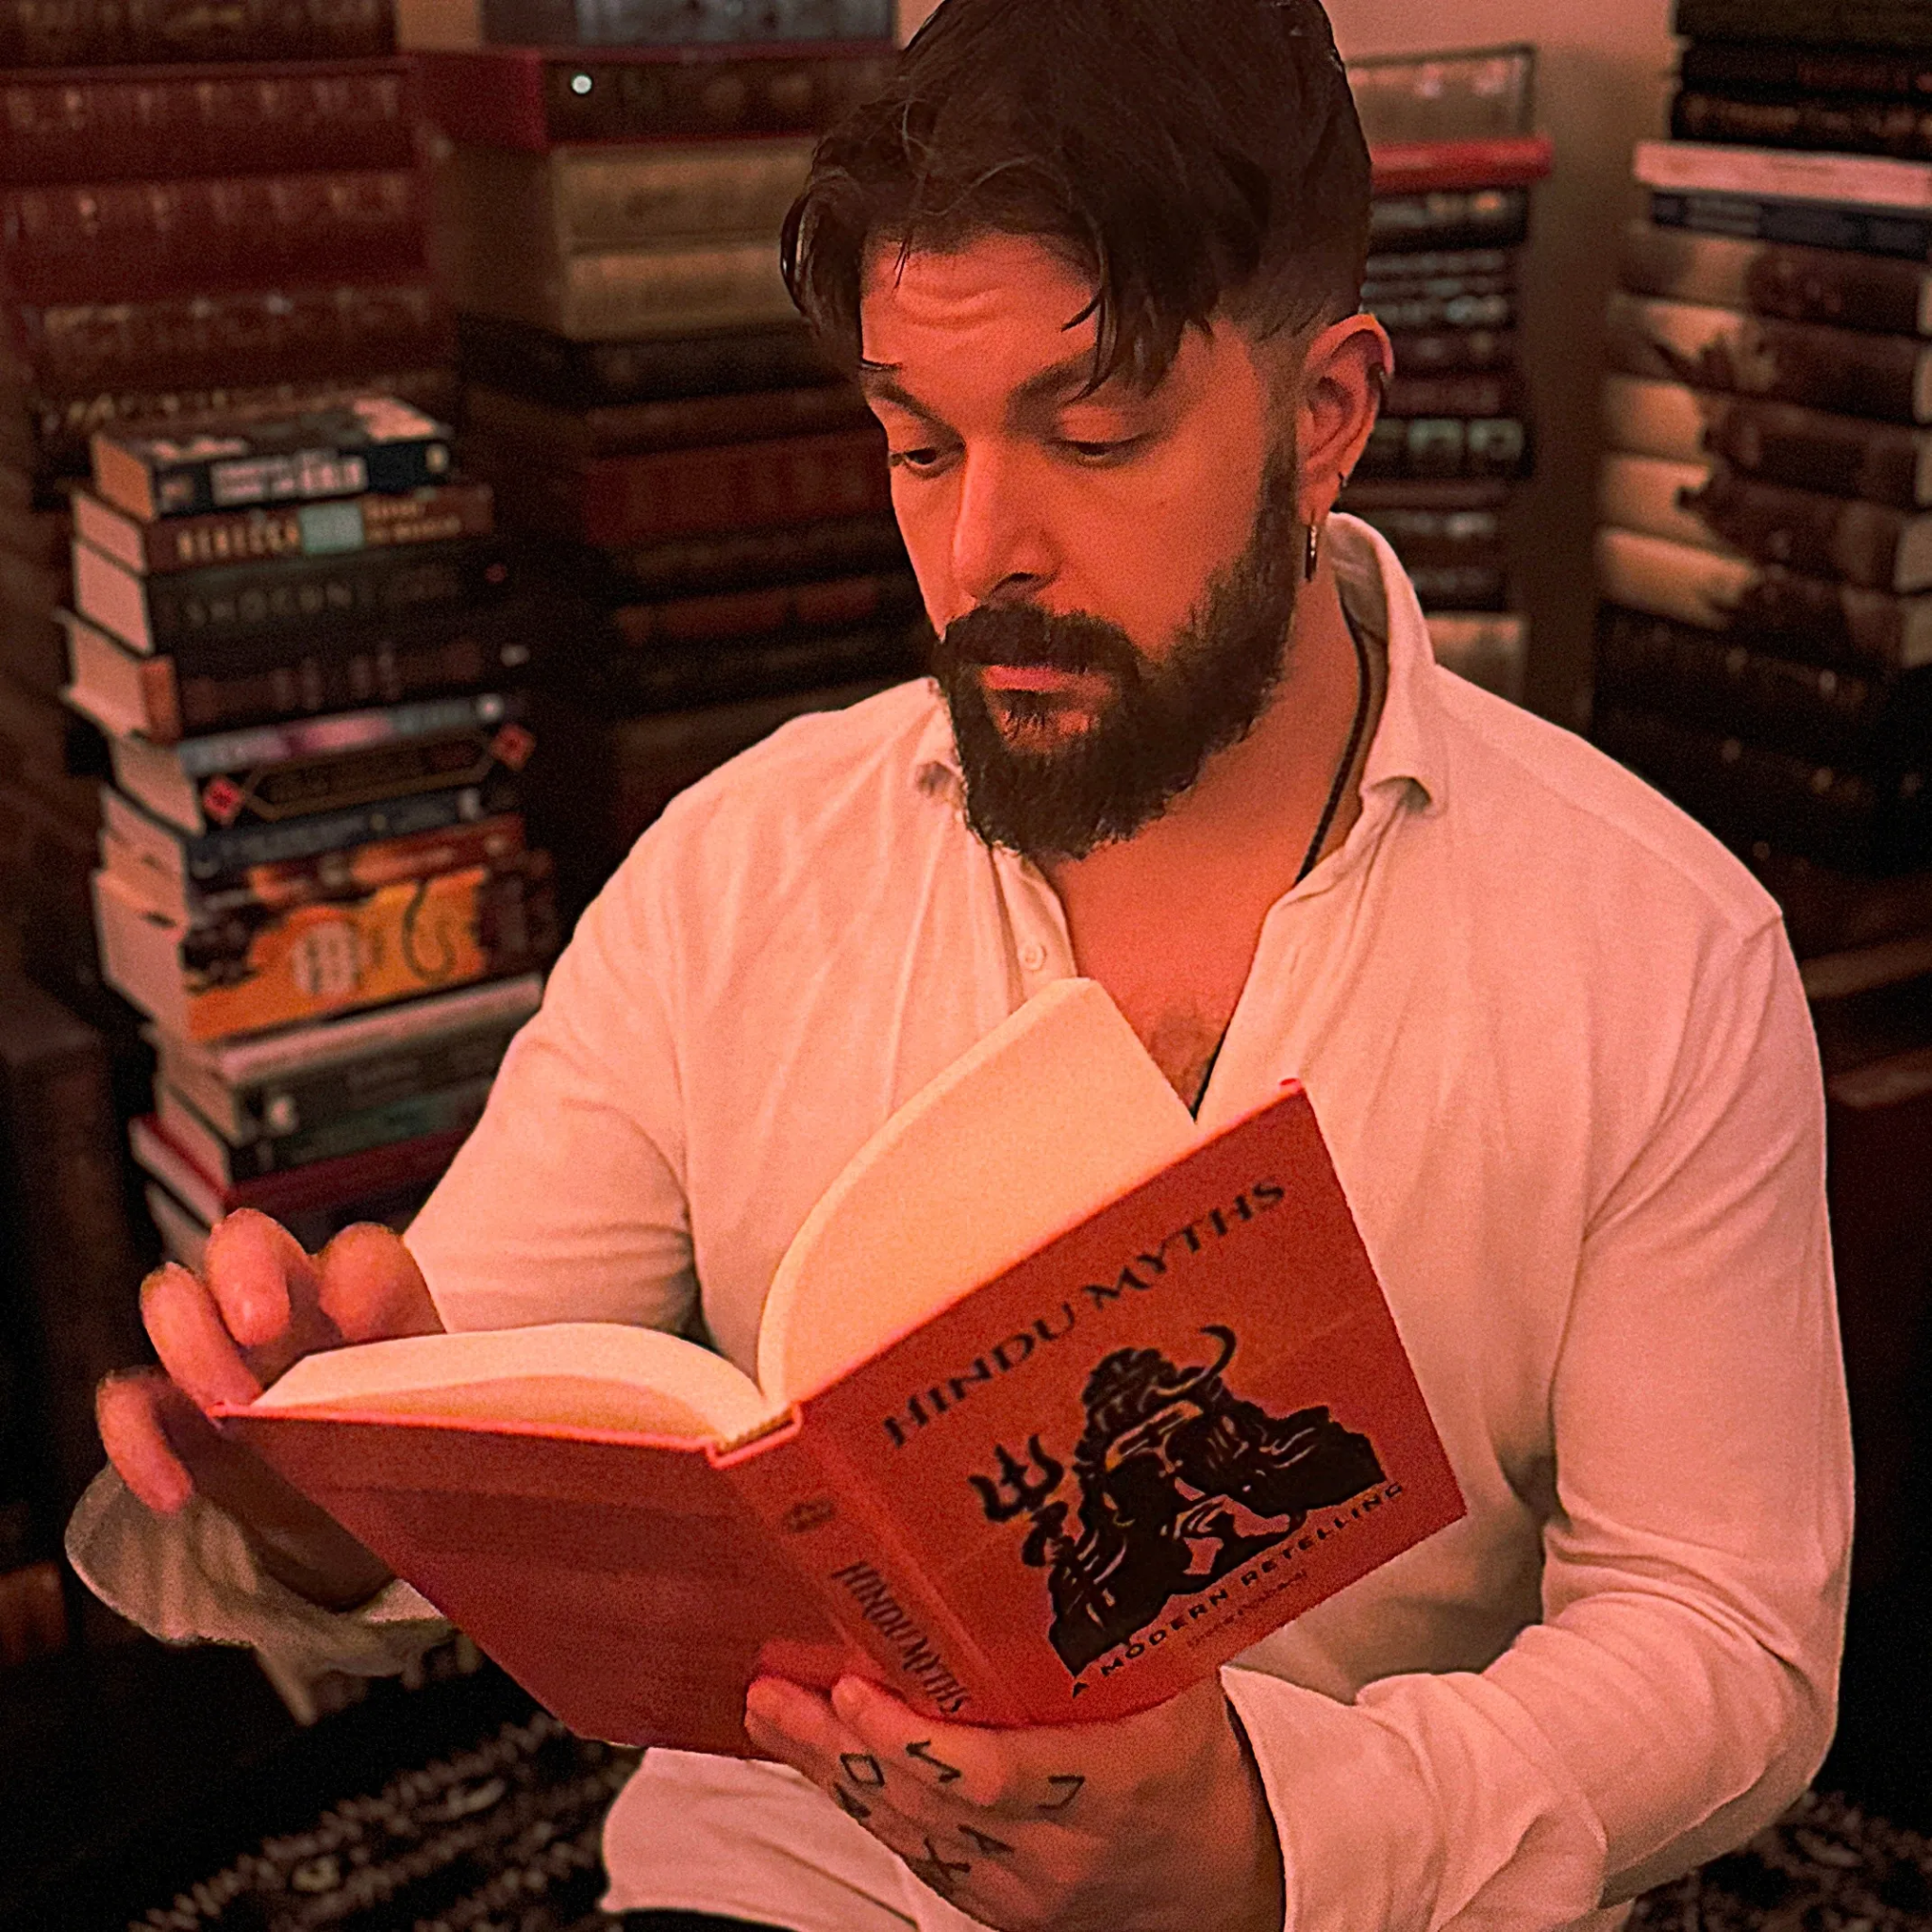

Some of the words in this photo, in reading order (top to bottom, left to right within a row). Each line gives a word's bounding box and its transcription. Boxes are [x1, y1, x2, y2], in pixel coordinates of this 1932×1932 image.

[882, 1301, 1076, 1450] HINDU
[1082, 1176, 1286, 1310] MYTHS
[830, 1561, 919, 1640] HINDU
[1073, 1682, 1091, 1700] A
[1101, 1590, 1229, 1677] MODERN
[1240, 1481, 1404, 1588] RETELLING
